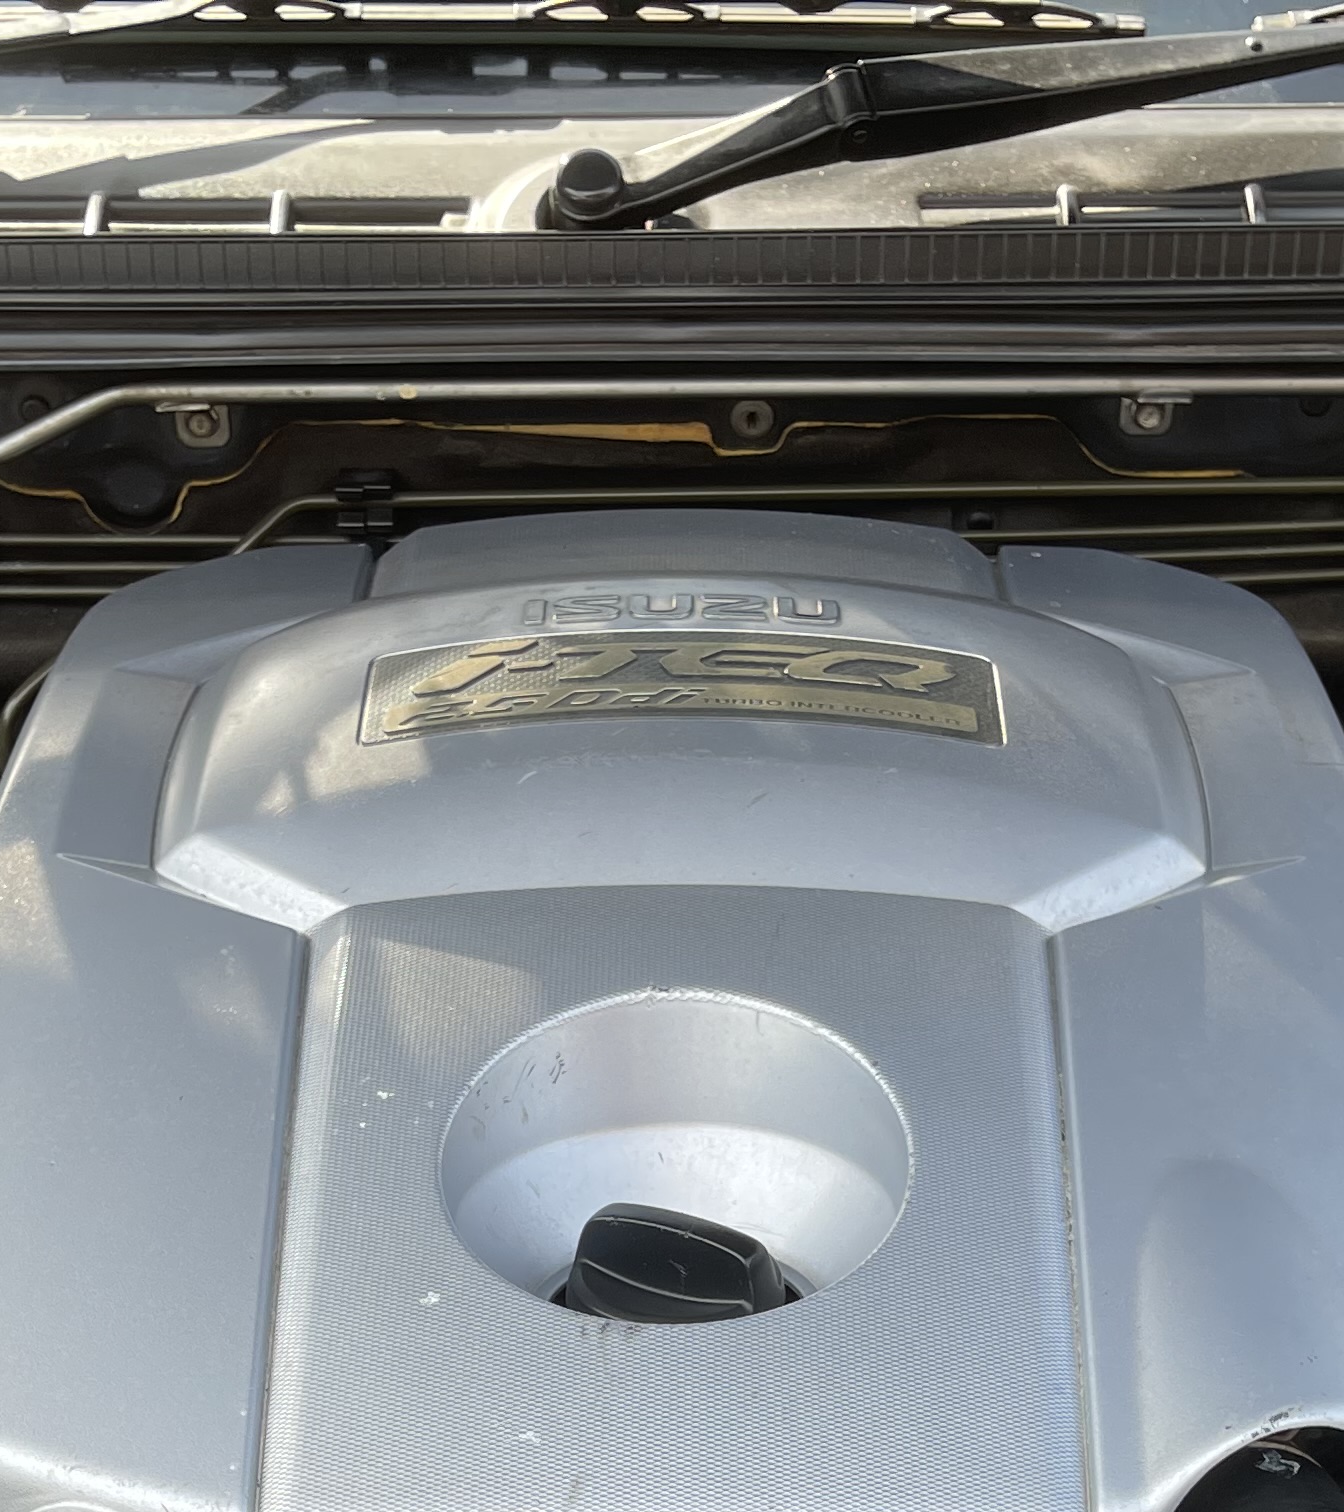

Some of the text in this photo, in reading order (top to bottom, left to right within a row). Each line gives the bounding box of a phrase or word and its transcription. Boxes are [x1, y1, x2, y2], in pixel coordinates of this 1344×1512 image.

[522, 593, 843, 627] ISUZU
[704, 697, 782, 708] TURBO
[791, 700, 961, 727] INTERCOOLER
